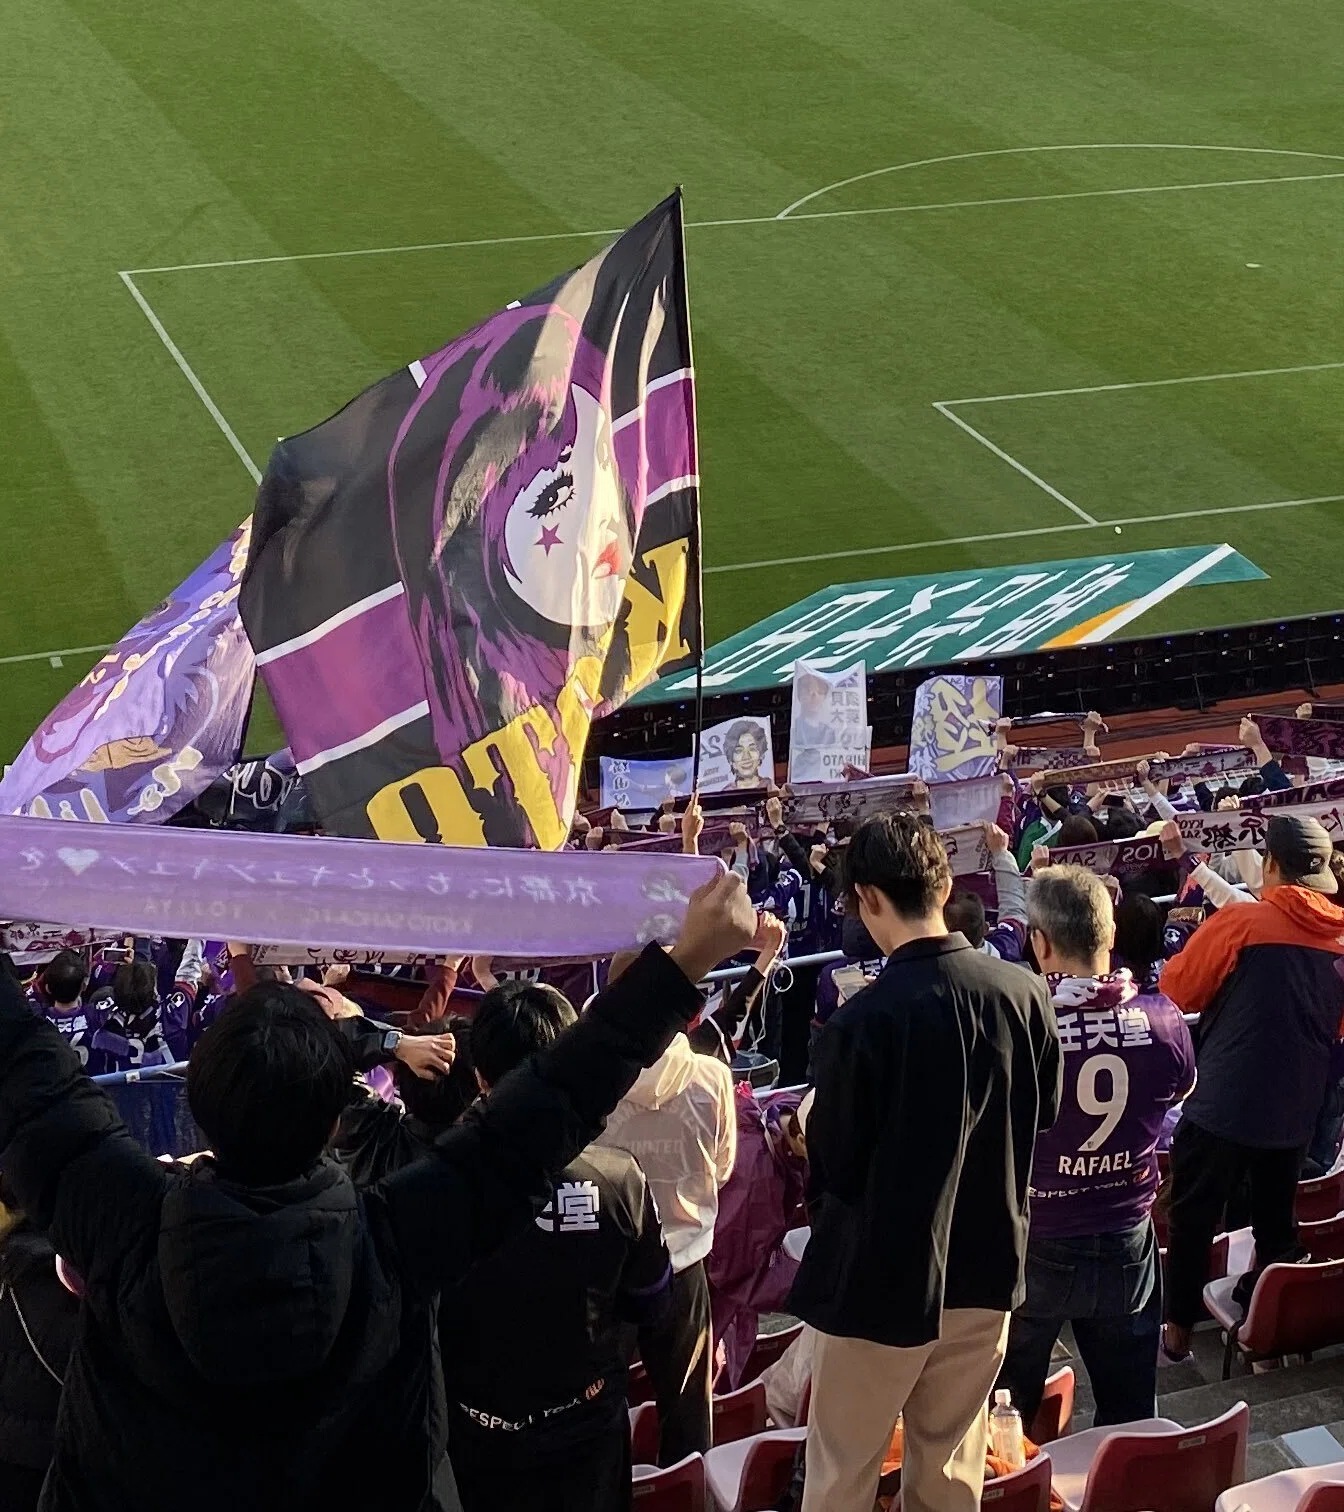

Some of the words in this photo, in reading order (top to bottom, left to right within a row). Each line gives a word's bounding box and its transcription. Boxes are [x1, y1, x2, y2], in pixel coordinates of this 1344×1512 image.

[1055, 1007, 1153, 1052] 任天堂
[1076, 1053, 1130, 1153] 9
[1058, 1150, 1133, 1177] RAFAEL
